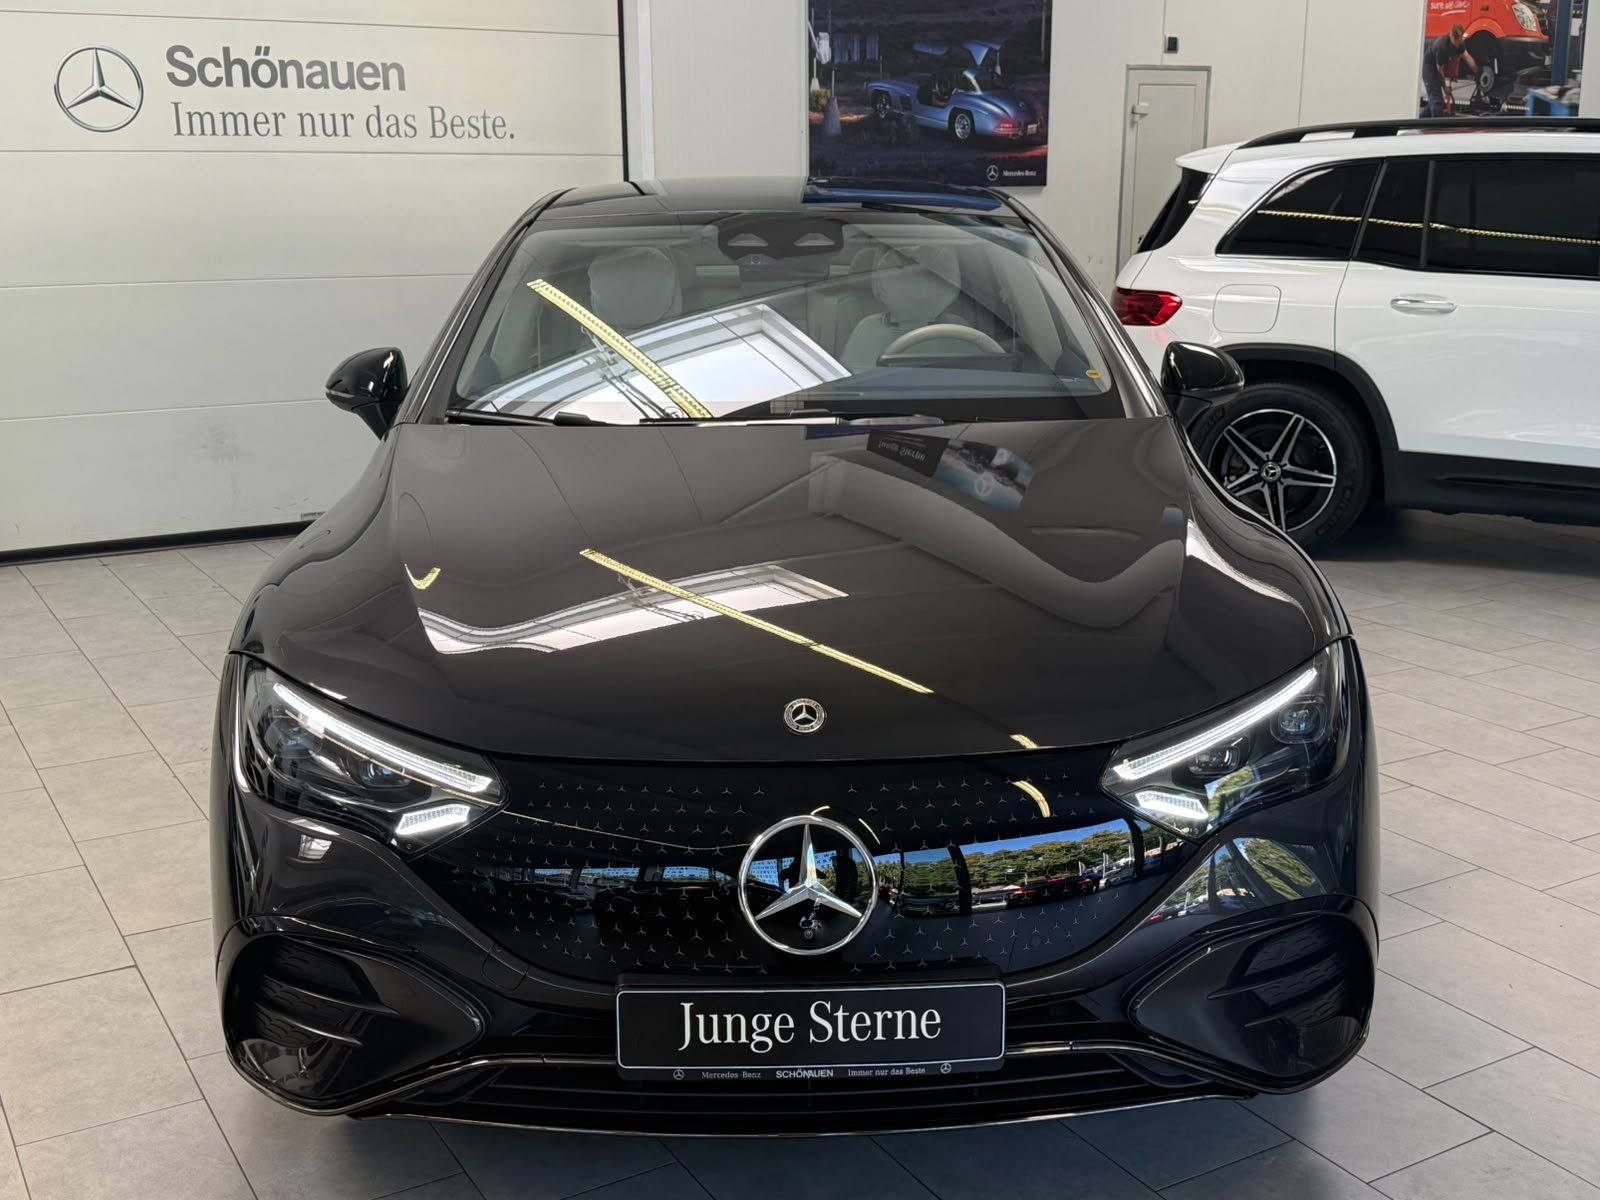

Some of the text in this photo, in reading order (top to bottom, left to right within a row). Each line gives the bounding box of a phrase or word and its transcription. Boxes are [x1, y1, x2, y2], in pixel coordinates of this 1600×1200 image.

[166, 45, 406, 91] Schönauen
[170, 102, 515, 140] Immer nur das Beste.
[678, 1000, 941, 1053] Junge Sterne
[701, 1071, 762, 1079] Mercedes-Benz
[775, 1068, 834, 1079] SCHÖNAUEN
[905, 1067, 926, 1075] Beste
